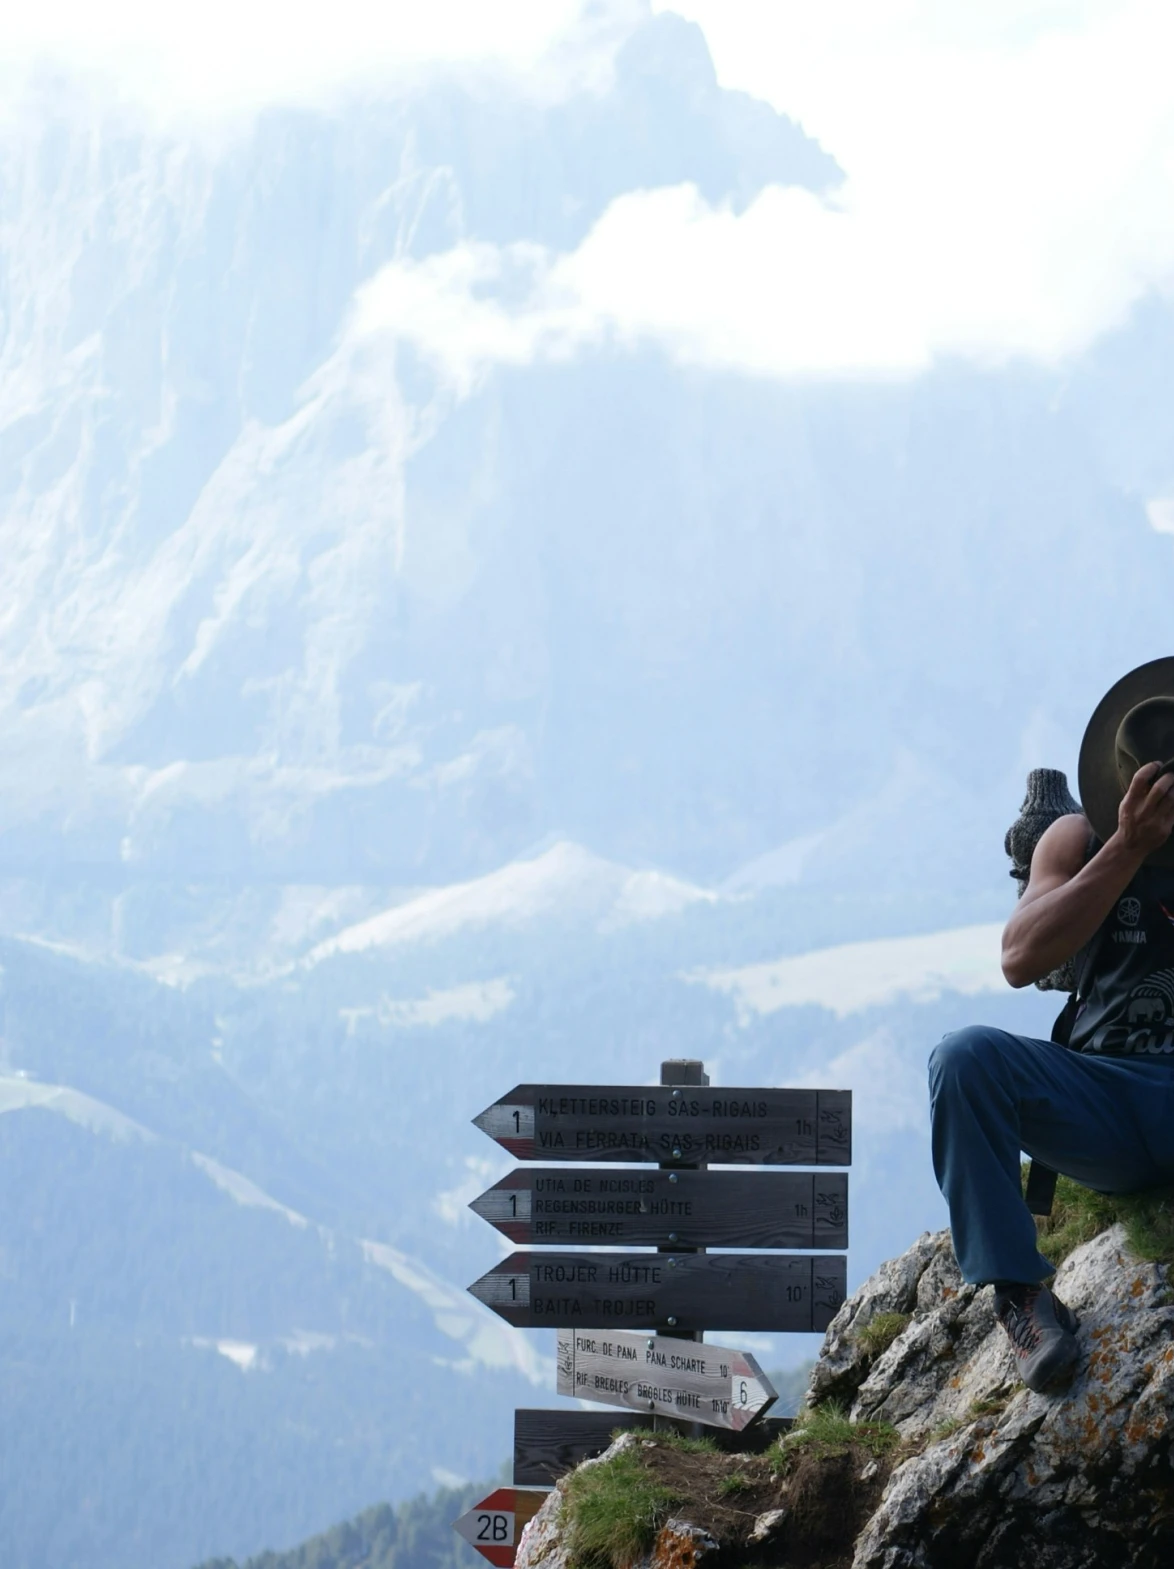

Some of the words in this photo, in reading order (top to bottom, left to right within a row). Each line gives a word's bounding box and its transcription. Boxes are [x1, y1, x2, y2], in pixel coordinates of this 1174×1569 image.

[538, 1098, 656, 1117] KLETTERSTEIG
[667, 1100, 768, 1118] SAS-RIGAIS
[512, 1110, 520, 1133] 1
[796, 1119, 812, 1136] 1h
[539, 1131, 565, 1148] VIA
[576, 1131, 650, 1150] FERRATA
[660, 1133, 760, 1151] SAS-RIGAIS
[535, 1179, 565, 1193] UTIA
[573, 1179, 592, 1193] DE
[509, 1194, 517, 1218] 1
[535, 1200, 642, 1215] REGENSBURGER
[651, 1198, 693, 1216] HÜTTE
[535, 1221, 560, 1236] RIF.
[568, 1221, 624, 1237] FIRENZE
[534, 1264, 597, 1283] TROJER
[609, 1263, 662, 1284] HÜTTE
[508, 1278, 516, 1301] 1
[533, 1299, 583, 1316] BAITA
[593, 1299, 657, 1317] TROJER
[576, 1338, 598, 1354] FURC.
[602, 1343, 614, 1357] DE
[616, 1344, 638, 1362] PANA
[646, 1350, 667, 1367] PANA
[671, 1356, 706, 1374] SCHARTE
[594, 1376, 629, 1395] BREGLES
[676, 1389, 701, 1409] HÜTTE
[739, 1381, 748, 1405] 6
[476, 1514, 508, 1541] 2B
